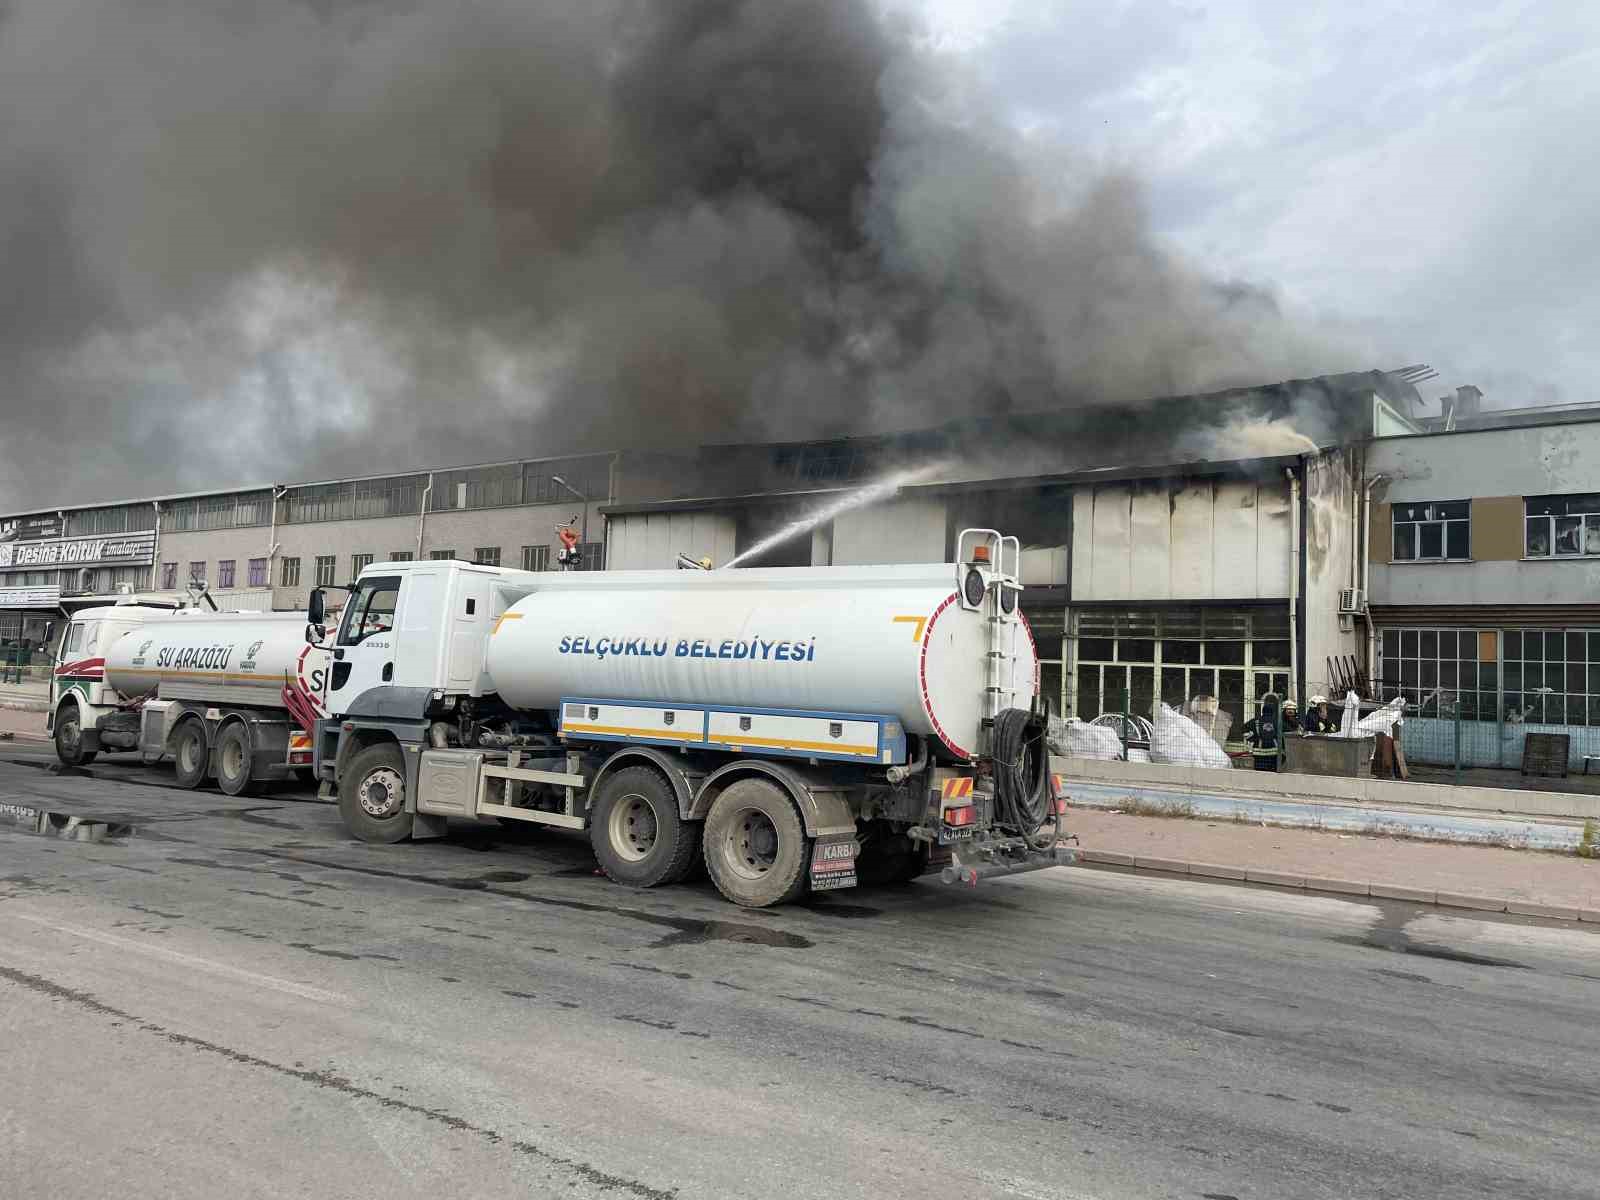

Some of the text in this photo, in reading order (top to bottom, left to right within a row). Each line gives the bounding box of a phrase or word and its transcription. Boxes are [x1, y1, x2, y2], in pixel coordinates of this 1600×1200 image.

[156, 647, 175, 668] SU
[174, 643, 234, 670] ARAZÖZÜ
[558, 635, 816, 662] SELÇUKLU BELEDİYESİ
